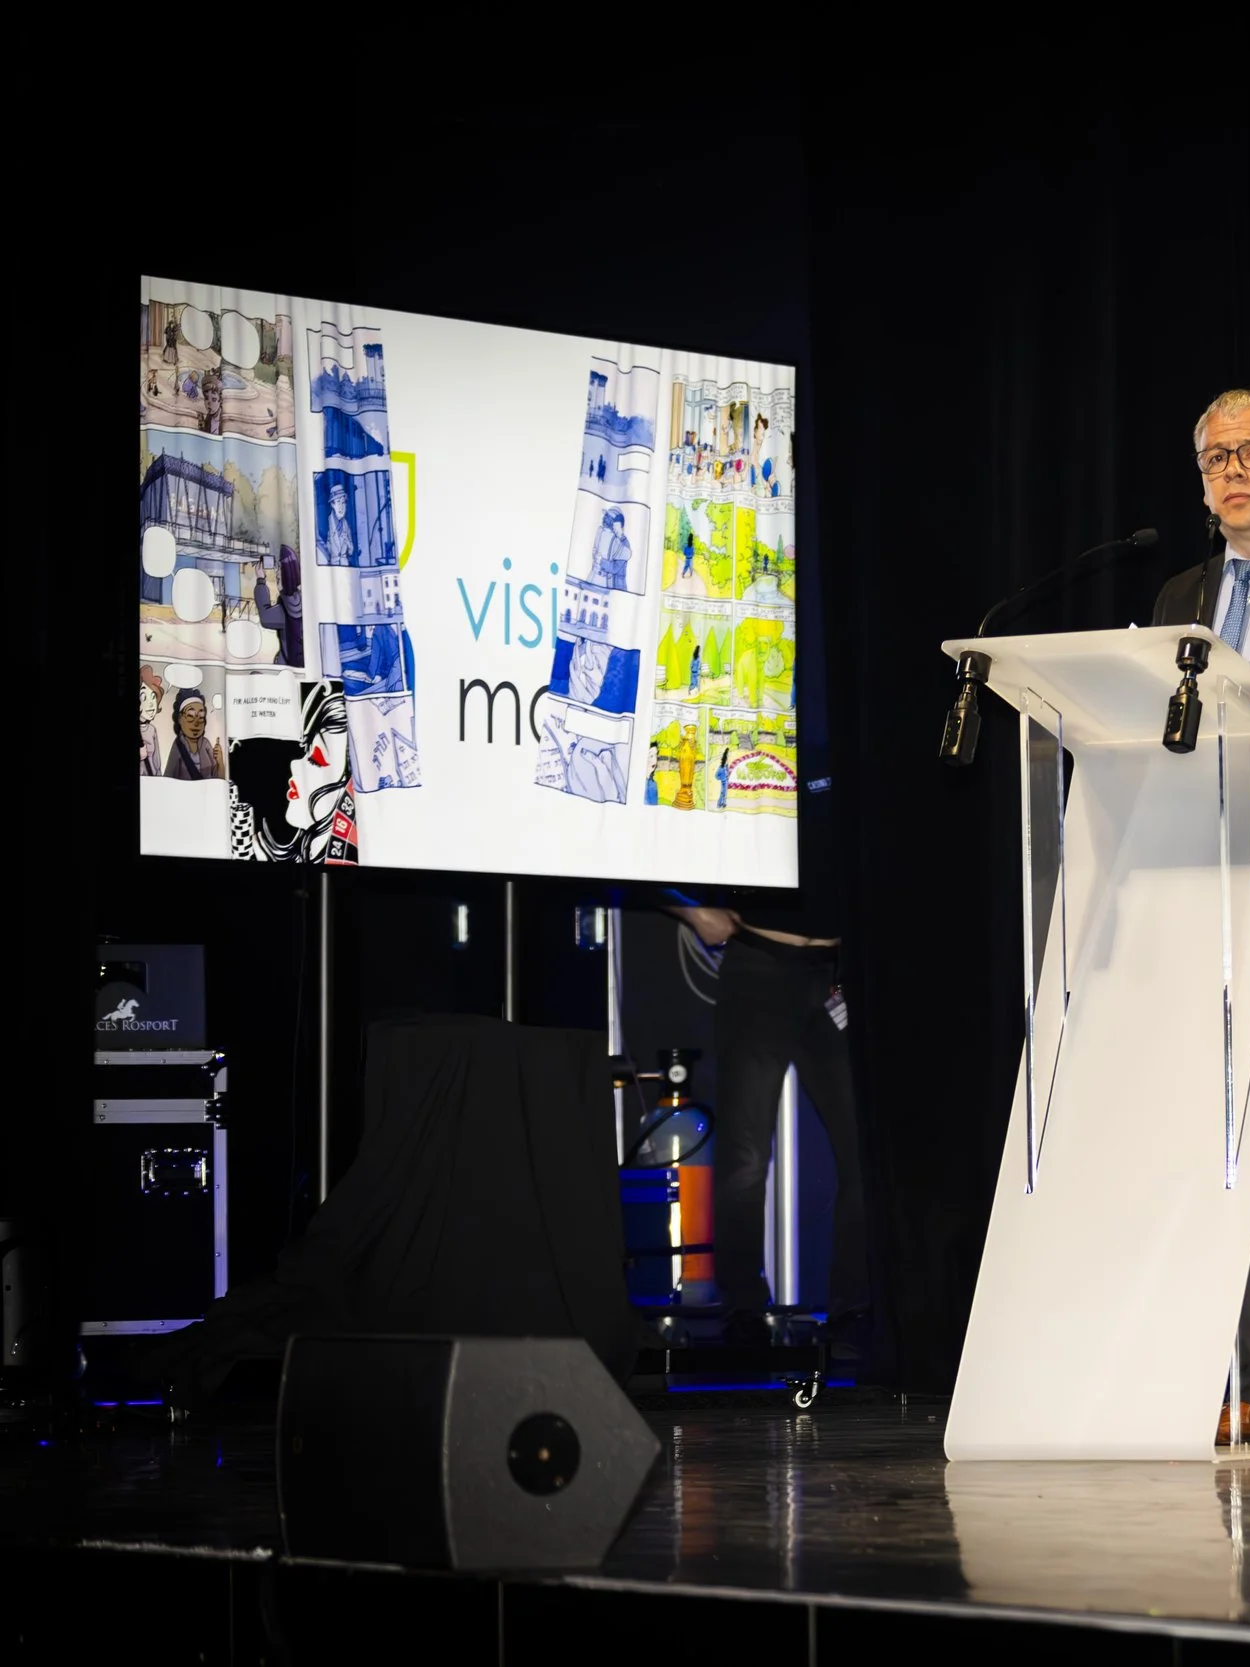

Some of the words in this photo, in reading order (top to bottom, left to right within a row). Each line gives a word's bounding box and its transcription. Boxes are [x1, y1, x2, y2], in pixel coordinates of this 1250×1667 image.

[456, 556, 559, 650] visi
[341, 796, 354, 816] 33
[334, 818, 348, 834] 16
[330, 840, 343, 857] 24
[95, 1020, 118, 1031] CES
